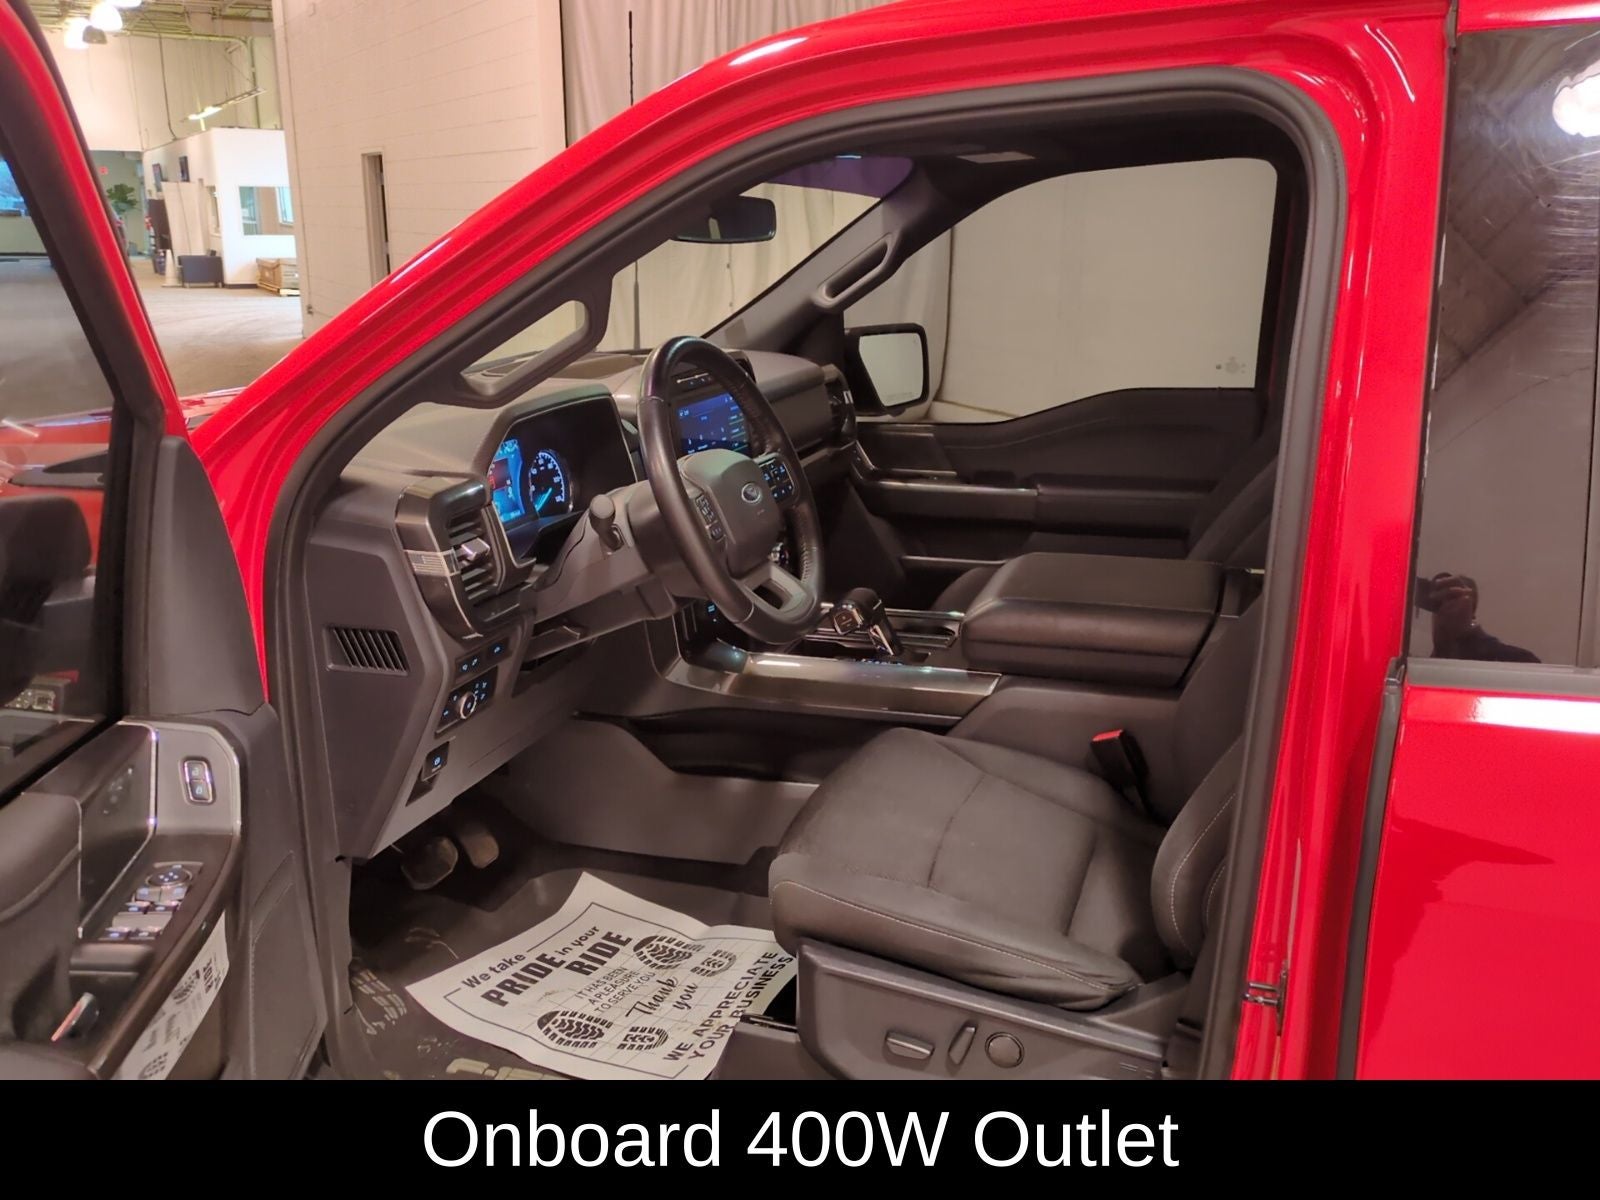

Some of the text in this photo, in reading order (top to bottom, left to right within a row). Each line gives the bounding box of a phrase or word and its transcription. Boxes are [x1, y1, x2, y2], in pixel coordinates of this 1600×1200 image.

[554, 926, 600, 956] in your
[564, 931, 634, 976] RIDE
[461, 953, 527, 989] We take
[480, 953, 567, 1007] PRIDE
[575, 966, 628, 999] IT HAS BEEN
[594, 970, 640, 1000] PLEASURE
[594, 971, 656, 1013] TO SERVE YOU
[625, 976, 679, 1018] Thank
[663, 951, 779, 1061] WE APPRECIATE
[672, 982, 699, 1011] you
[688, 956, 794, 1060] YOUR BUSINESS
